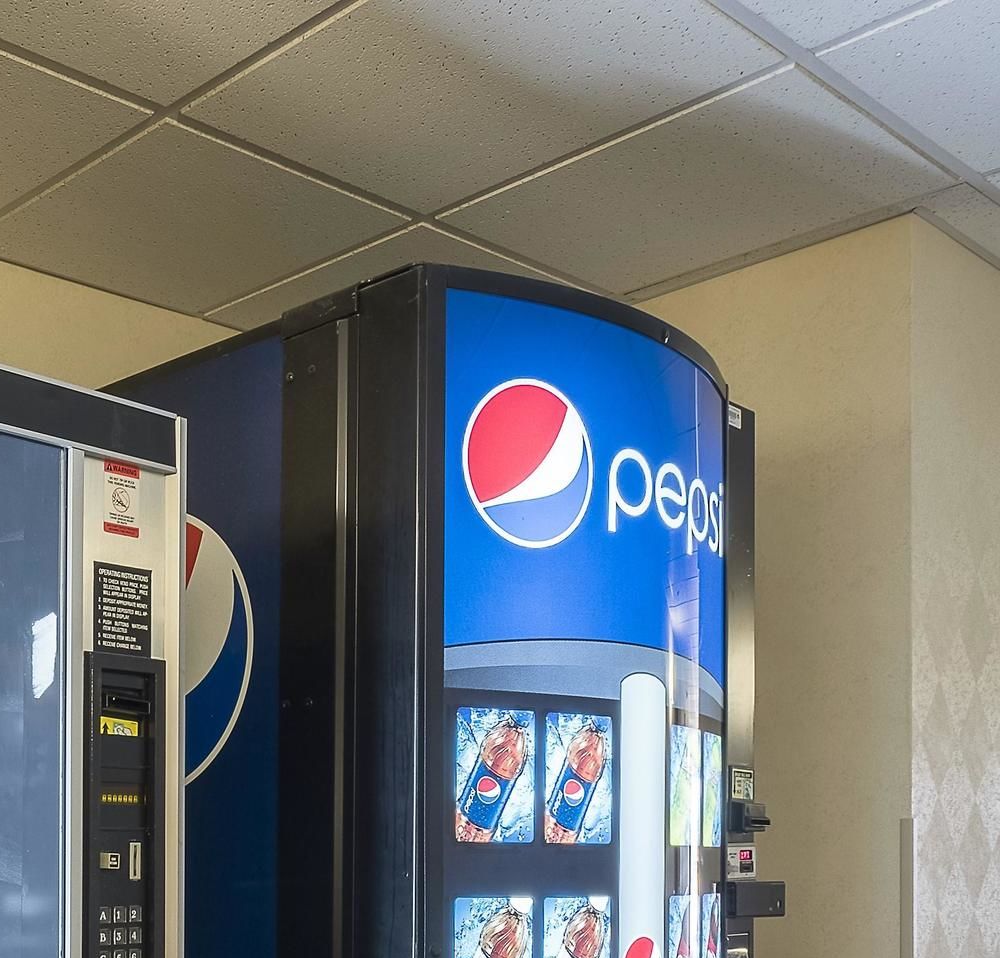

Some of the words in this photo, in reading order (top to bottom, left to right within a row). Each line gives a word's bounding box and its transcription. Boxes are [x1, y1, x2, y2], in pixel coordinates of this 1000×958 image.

[608, 448, 725, 558] pepsi
[100, 912, 107, 920] A
[100, 933, 107, 942] B
